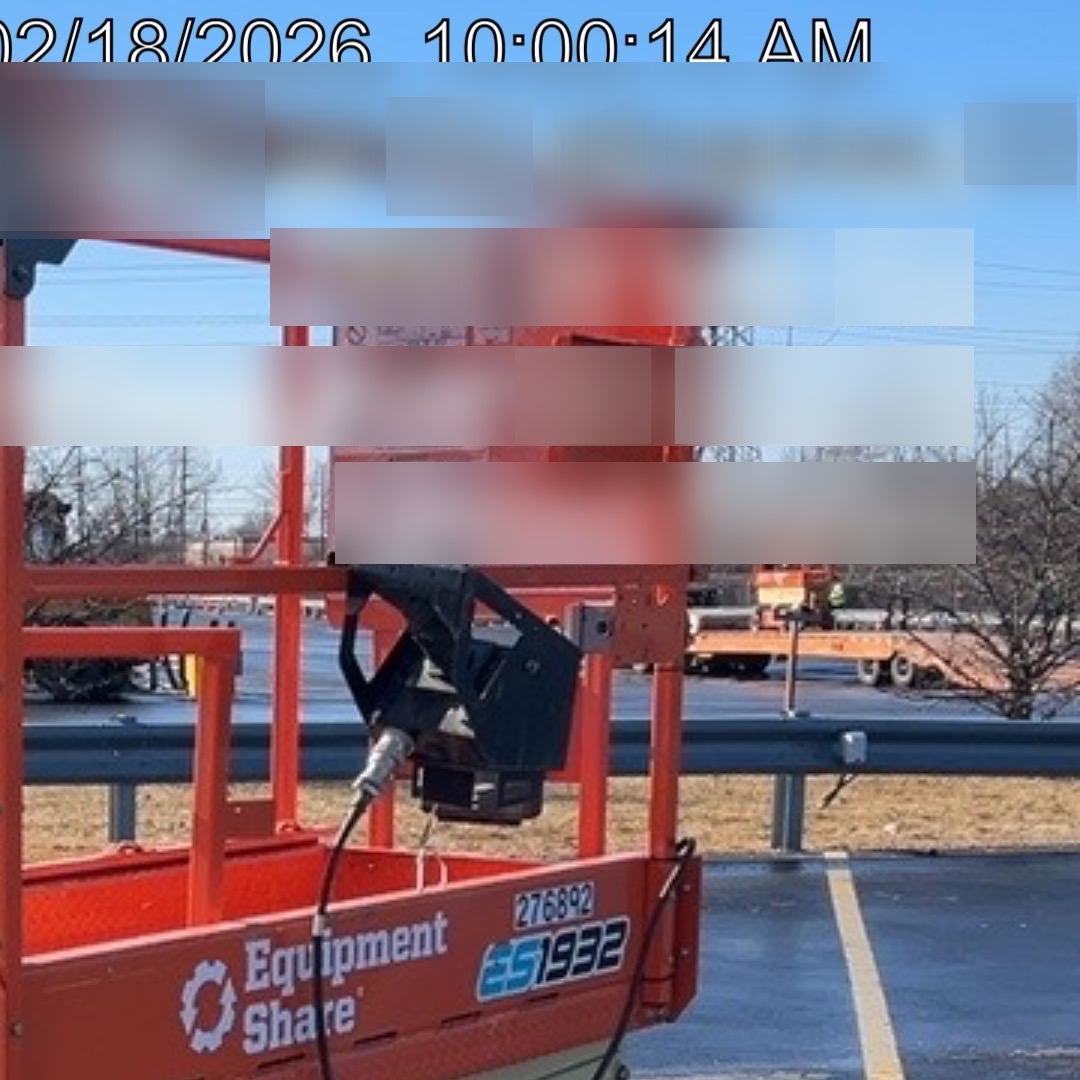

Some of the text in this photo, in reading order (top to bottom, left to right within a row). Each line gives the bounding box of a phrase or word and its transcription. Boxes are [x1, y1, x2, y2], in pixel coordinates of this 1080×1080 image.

[516, 884, 592, 928] 276892
[245, 911, 449, 997] Equipment
[477, 915, 630, 1003] ES1932
[243, 996, 356, 1055] Share
